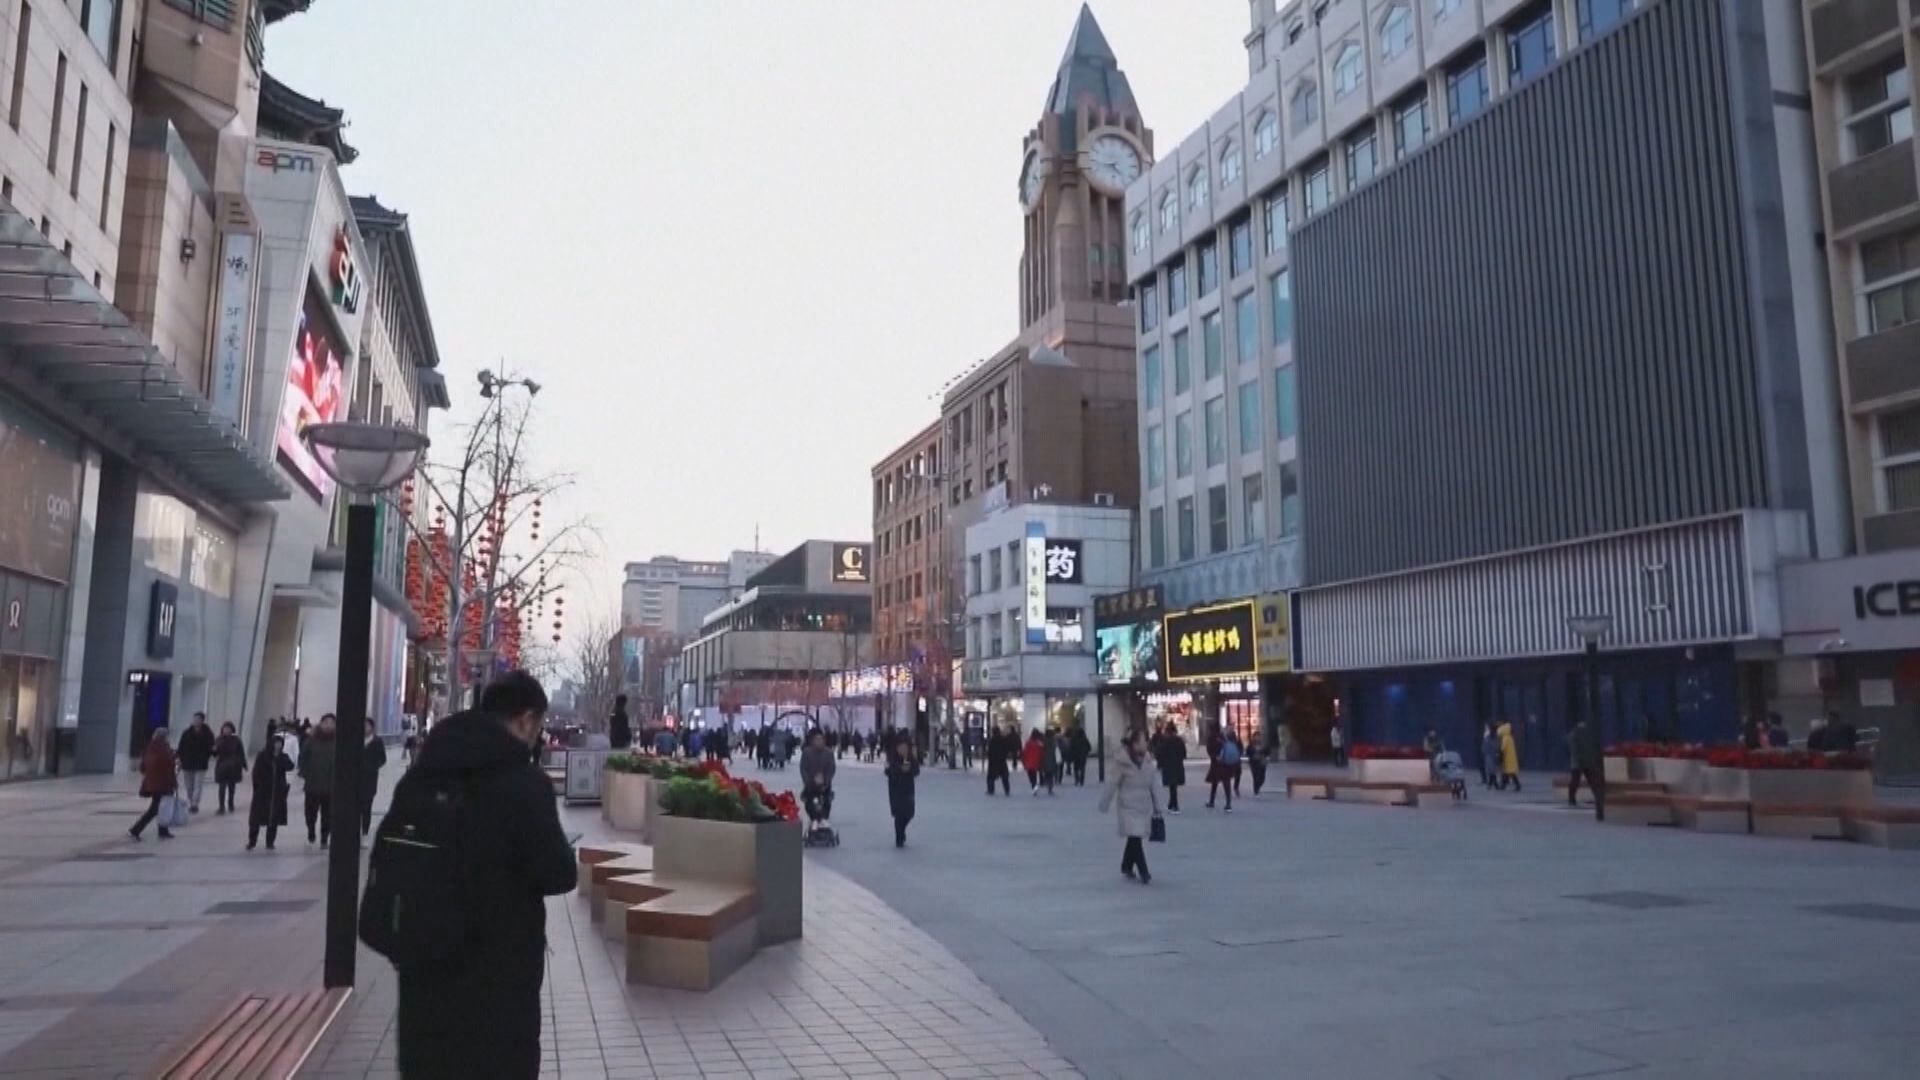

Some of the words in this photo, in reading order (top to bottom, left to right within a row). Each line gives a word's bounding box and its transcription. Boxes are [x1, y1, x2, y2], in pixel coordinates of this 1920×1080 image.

[257, 151, 314, 173] apm
[842, 547, 862, 568] C
[1046, 545, 1077, 578] 药
